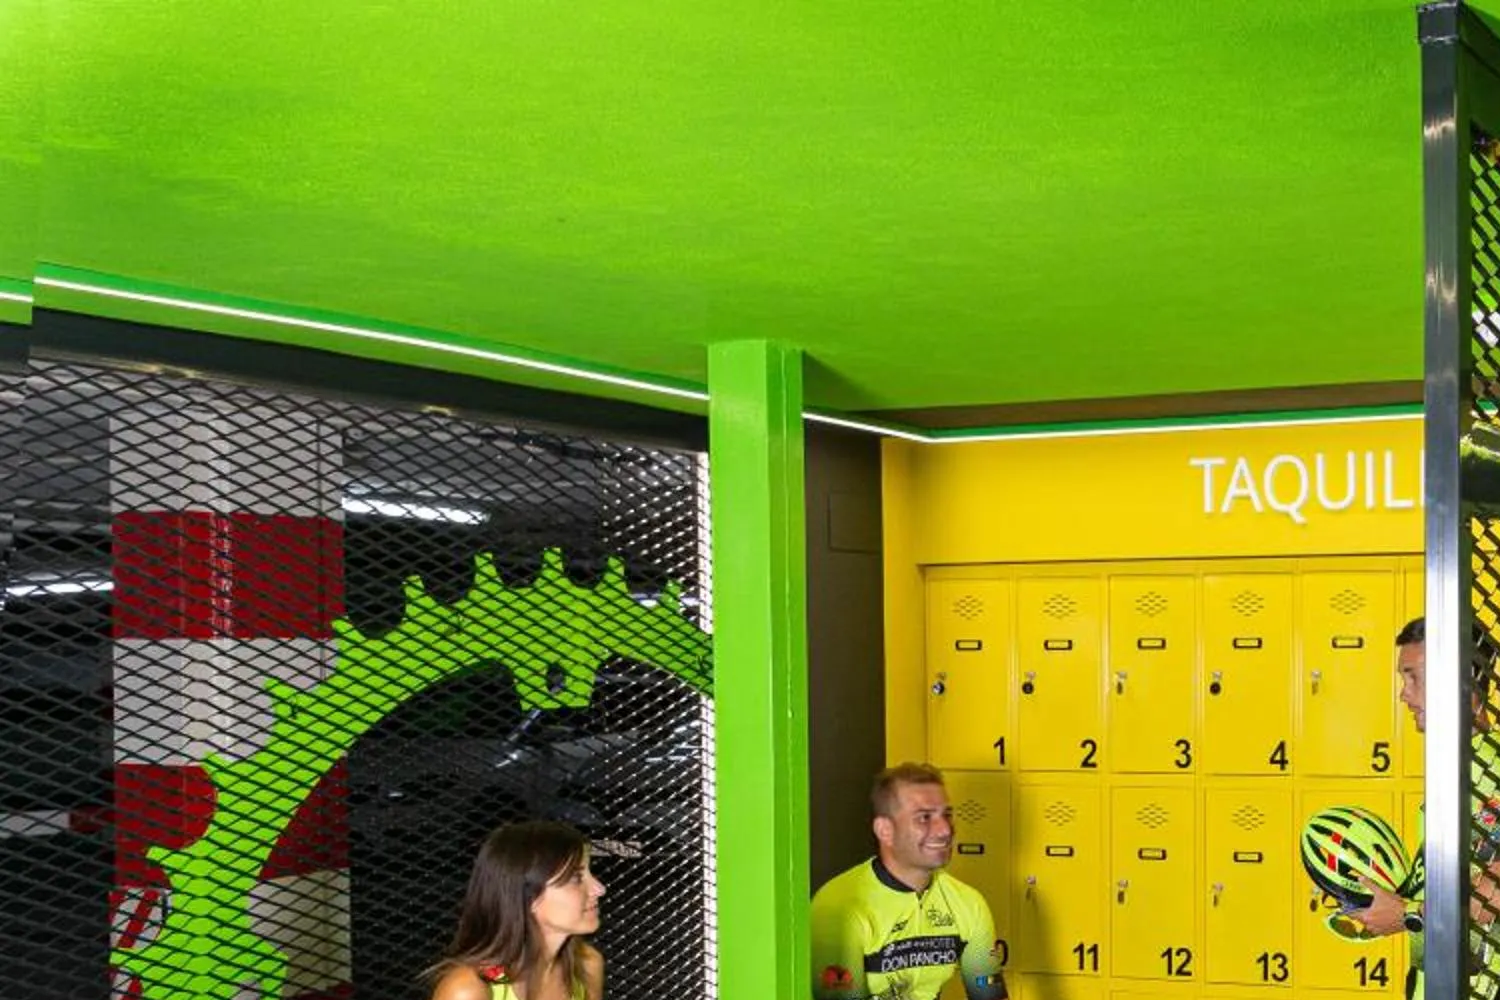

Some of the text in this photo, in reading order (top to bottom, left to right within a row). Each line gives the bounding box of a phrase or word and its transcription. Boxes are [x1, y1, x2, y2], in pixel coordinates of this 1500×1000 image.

[1189, 450, 1425, 524] TAQUIL
[994, 737, 1006, 765] 1
[1080, 739, 1098, 768] 2
[1174, 739, 1192, 769] 3
[1269, 741, 1289, 770] 4
[1371, 742, 1391, 772] 5
[881, 950, 957, 972] DON PANCHO
[1073, 943, 1100, 972] 11
[1160, 947, 1193, 977] 12
[1256, 951, 1290, 982] 13
[1353, 957, 1389, 987] 14
